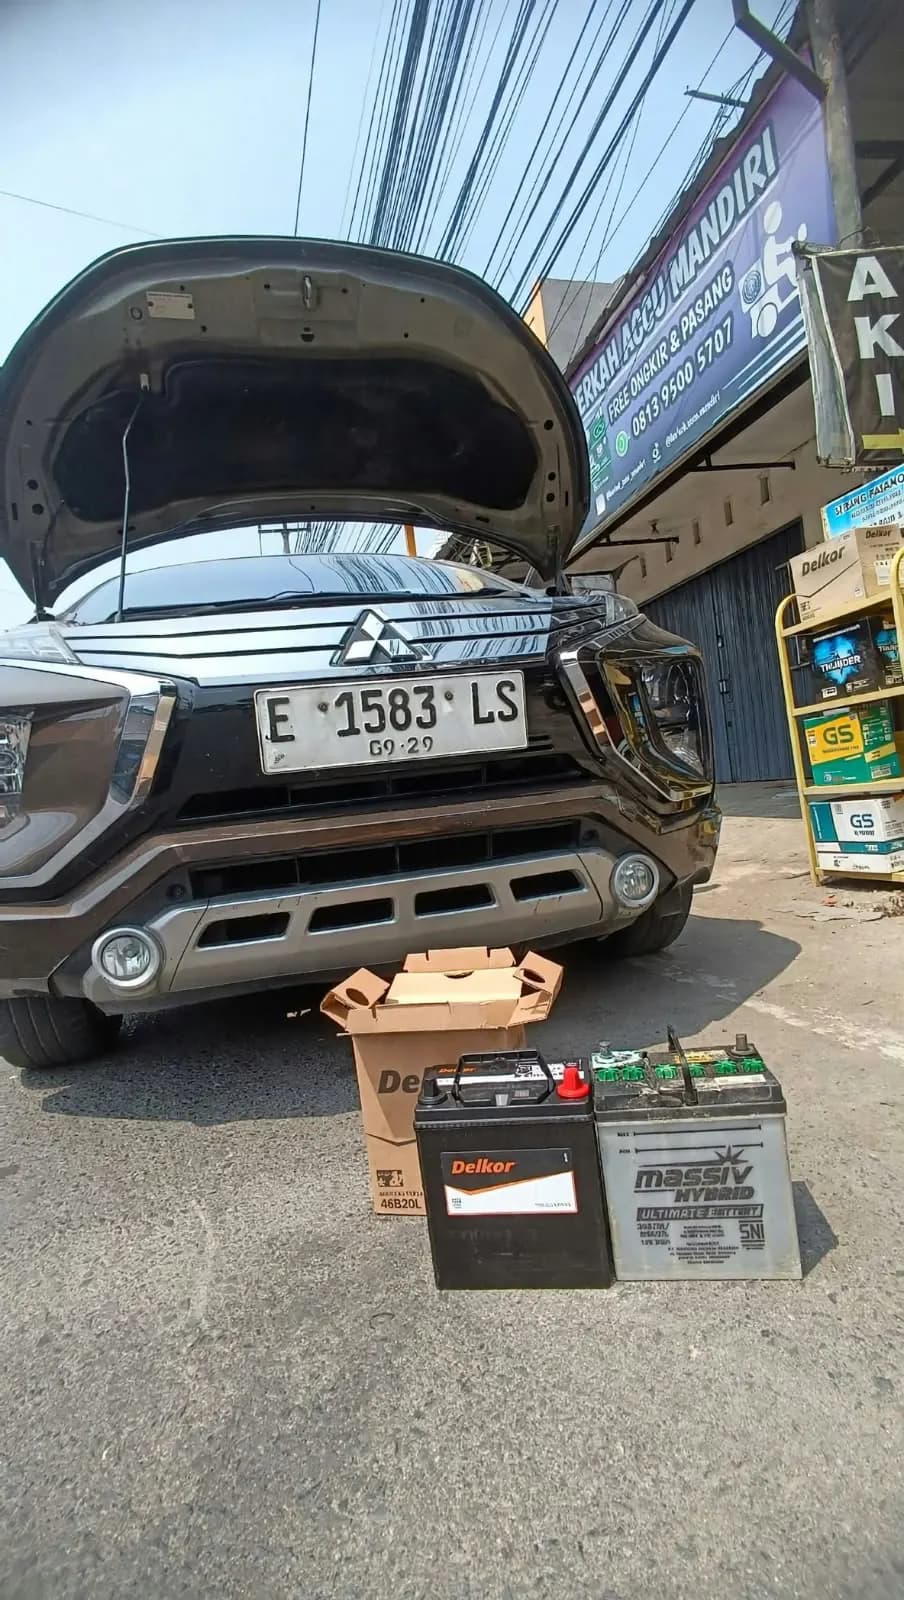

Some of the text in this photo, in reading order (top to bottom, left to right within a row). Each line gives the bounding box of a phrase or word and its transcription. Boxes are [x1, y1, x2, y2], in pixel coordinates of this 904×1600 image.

[621, 275, 667, 361] ACCU
[669, 125, 776, 298] MANDIRI
[608, 386, 630, 422] FREE
[630, 341, 669, 397] ONGKIR
[669, 331, 680, 353] &
[681, 265, 733, 341] PASANG
[847, 255, 904, 416] AKI
[632, 316, 732, 437] 0813 9500 5707
[802, 545, 846, 577] Delkor
[820, 655, 861, 673] THUNDER
[266, 680, 519, 743] E 1583 LS
[823, 724, 854, 745] GS
[850, 813, 875, 829] GS
[451, 1158, 517, 1175] Delkor
[380, 1198, 422, 1209] 46B20L
[673, 1186, 755, 1203] HYBRID
[641, 1207, 705, 1220] ULTIMATE
[739, 1223, 765, 1240] SNI
